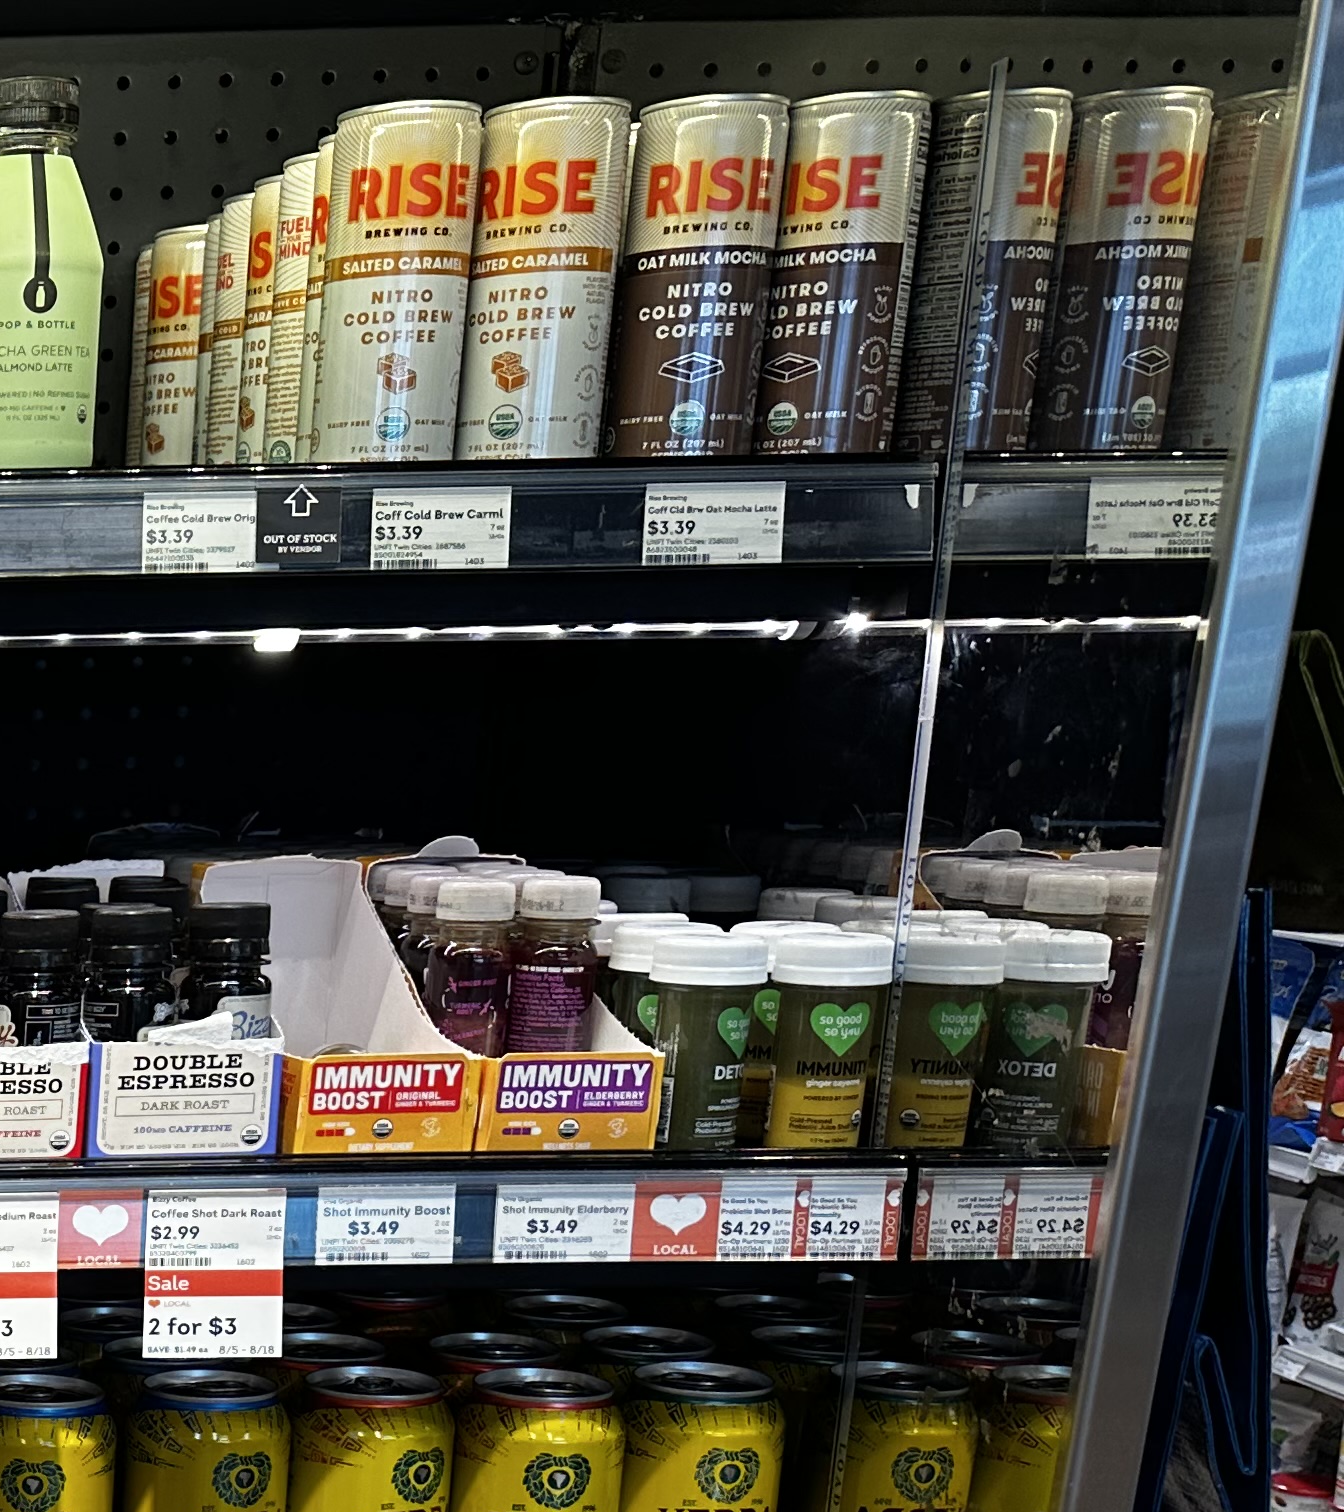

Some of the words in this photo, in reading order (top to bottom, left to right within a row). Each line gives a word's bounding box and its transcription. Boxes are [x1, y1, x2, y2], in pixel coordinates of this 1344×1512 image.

[348, 162, 472, 224] RISE
[343, 256, 396, 275] SALTED
[398, 255, 463, 272] CARAMEL
[638, 254, 666, 270] OAT
[668, 253, 711, 269] MILK
[714, 251, 767, 266] MOCHA
[371, 288, 434, 304] NITRO
[360, 327, 436, 344] COFFEE
[263, 534, 285, 544] OUT
[288, 534, 300, 543] OF
[303, 534, 337, 543] STOCK
[375, 526, 422, 541] $3.39
[133, 1054, 243, 1071] DOUBLE
[117, 1073, 255, 1091] ESPRESSO
[503, 1064, 651, 1088] IMMUNITY
[140, 1100, 178, 1111] DARK
[182, 1099, 230, 1110] ROAST
[500, 1091, 572, 1109] BOOST
[151, 1226, 200, 1241] $2.99
[721, 1220, 771, 1236] $4.29
[652, 1244, 698, 1255] LOCAL
